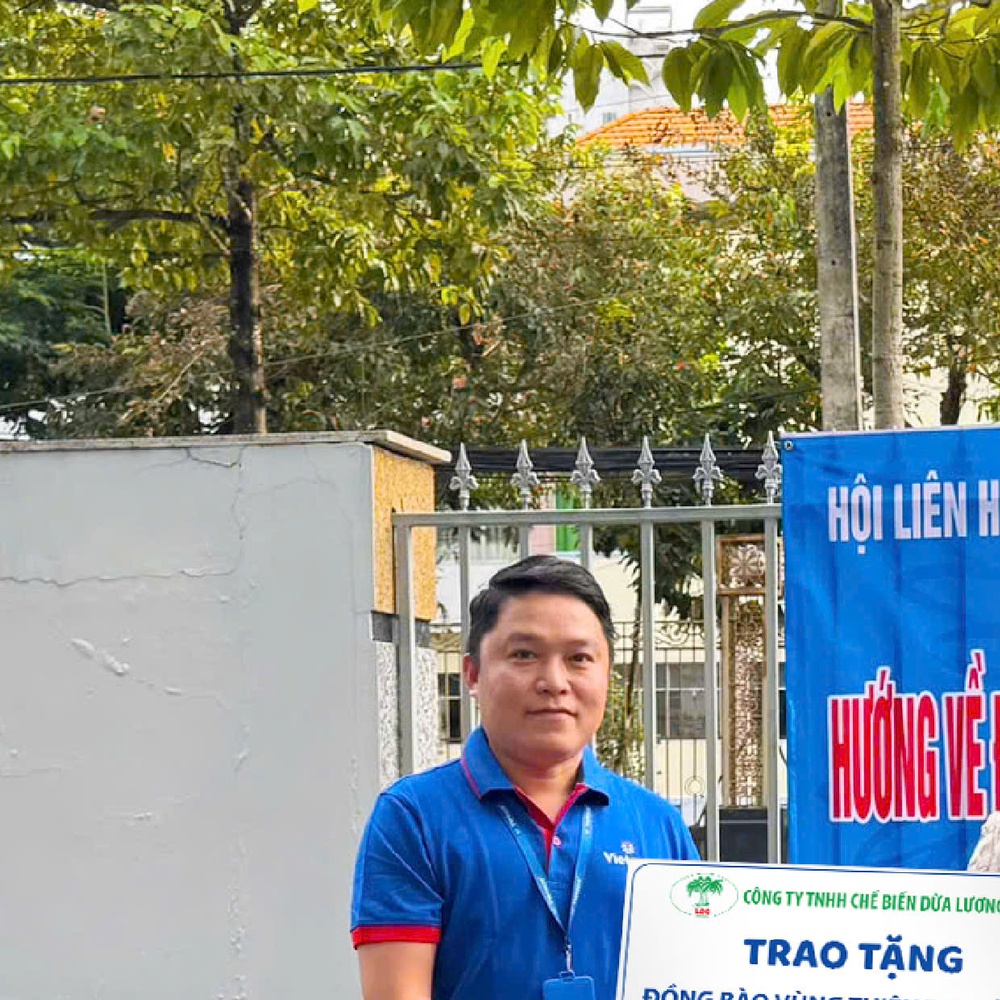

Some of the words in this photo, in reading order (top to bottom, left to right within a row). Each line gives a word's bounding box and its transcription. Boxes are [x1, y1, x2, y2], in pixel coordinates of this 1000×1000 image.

[827, 473, 884, 554] HỘI
[893, 470, 967, 539] LIÊN
[828, 666, 940, 823] HƯỚNG
[942, 650, 987, 821] VỀ
[743, 886, 782, 906] CÔNG
[785, 891, 804, 907] TY
[805, 891, 847, 909] TNHH
[850, 889, 880, 910] CHẾ
[882, 891, 917, 912] BIẾN
[919, 893, 951, 912] DỪA
[744, 938, 849, 971] TRAO
[858, 935, 964, 980] TẶNG
